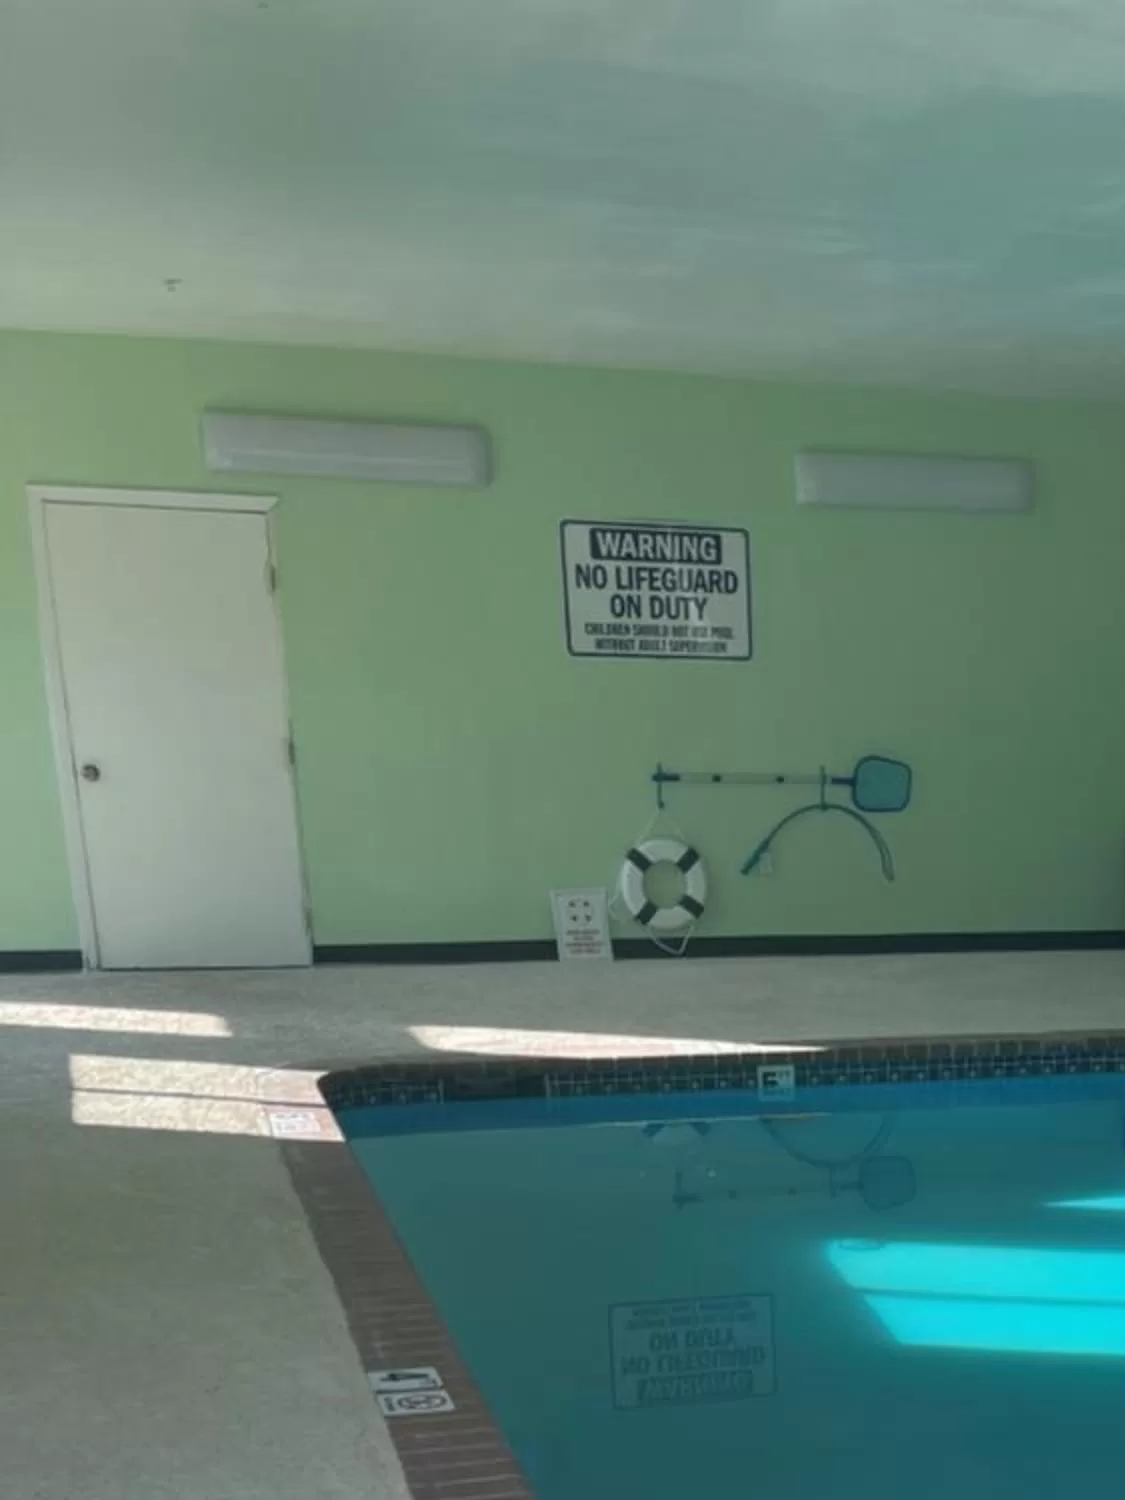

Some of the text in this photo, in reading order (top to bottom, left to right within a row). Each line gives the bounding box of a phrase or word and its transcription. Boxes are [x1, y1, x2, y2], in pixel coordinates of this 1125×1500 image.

[596, 531, 718, 562] WARNING
[575, 564, 738, 594] NO LIFEGUARD
[610, 594, 708, 620] ON DUTY
